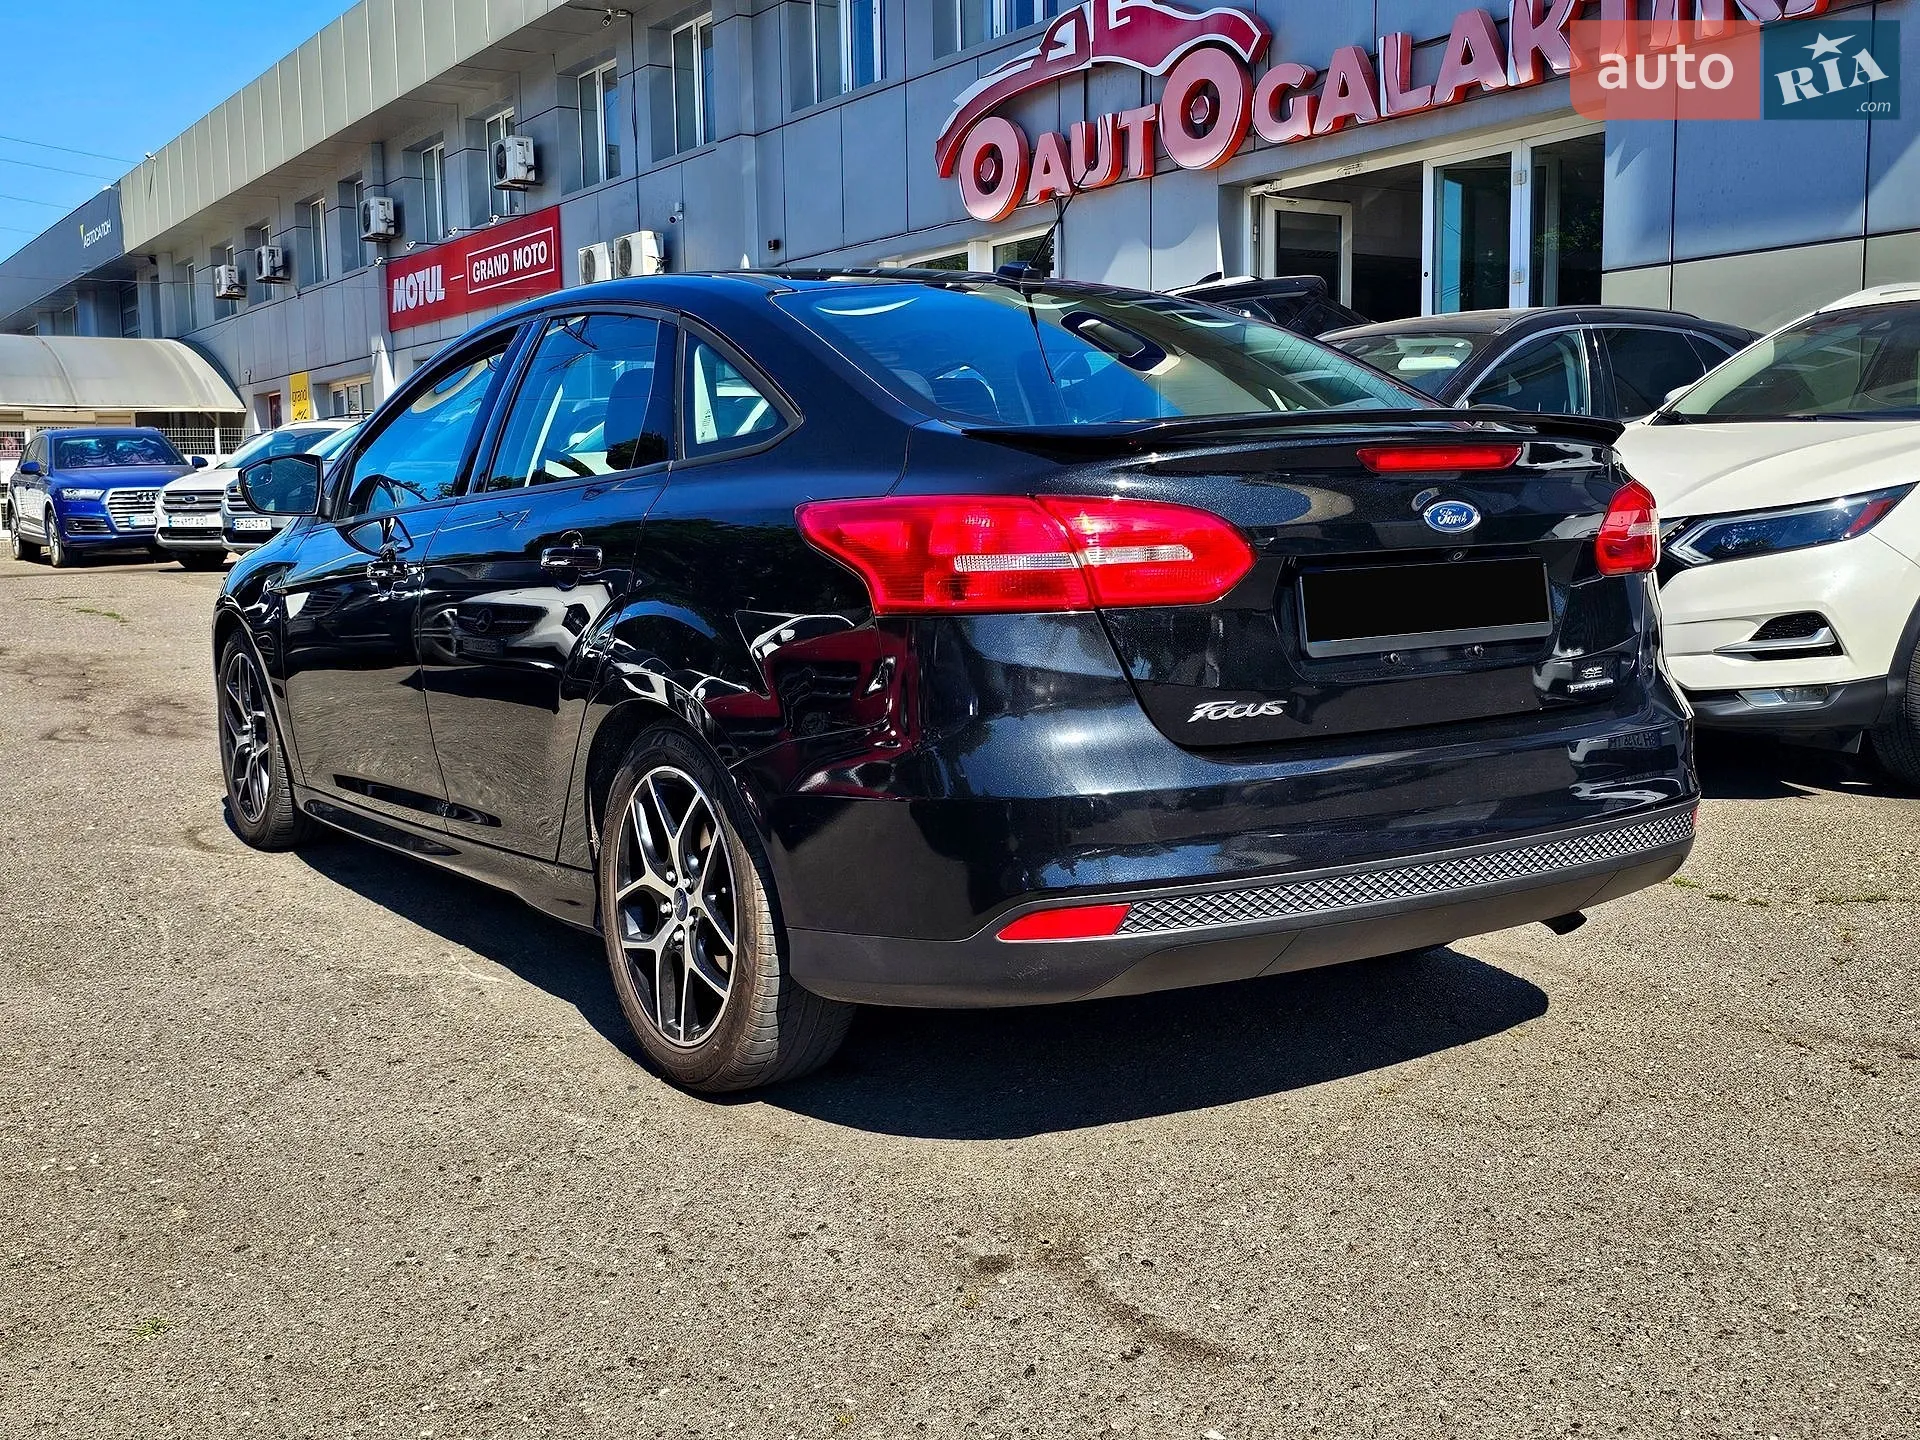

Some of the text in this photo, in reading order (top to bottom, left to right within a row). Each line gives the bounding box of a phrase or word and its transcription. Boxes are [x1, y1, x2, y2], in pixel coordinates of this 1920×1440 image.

[392, 240, 548, 314] MOTUL GRAND MOTO
